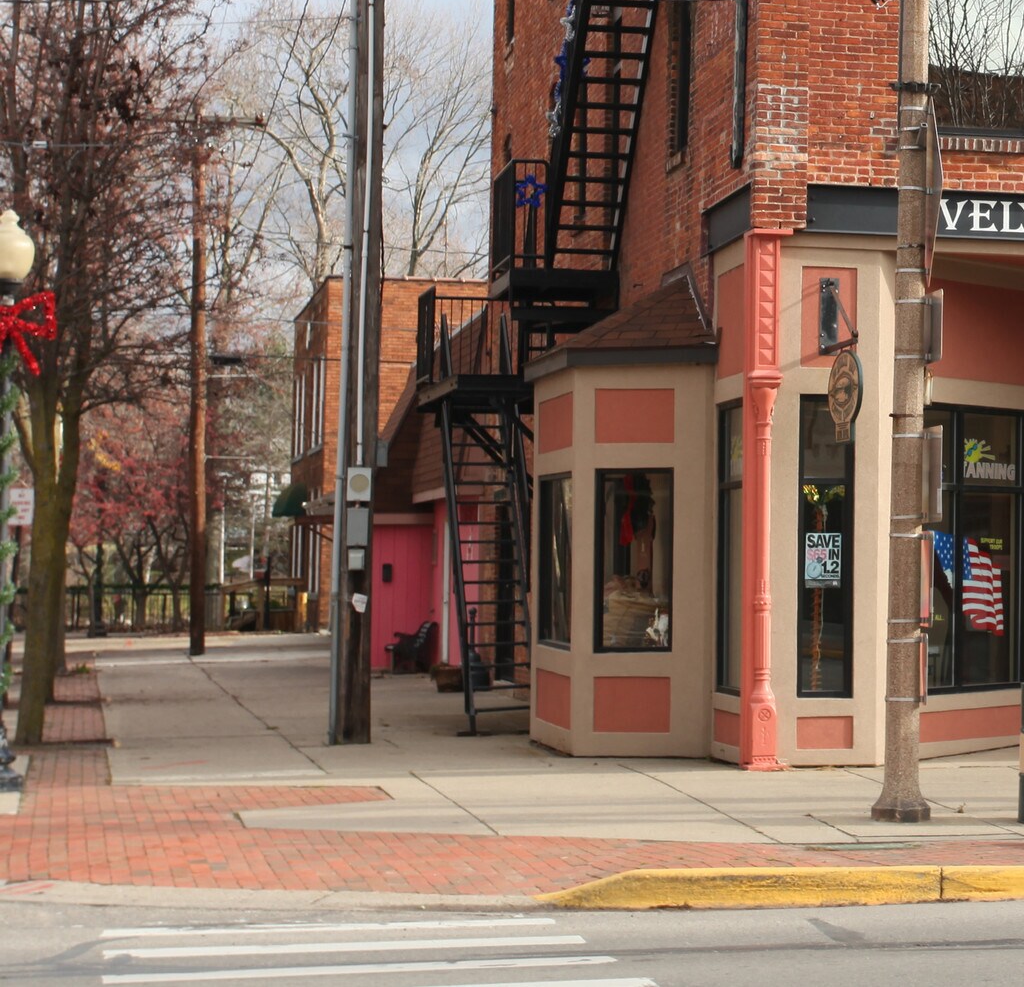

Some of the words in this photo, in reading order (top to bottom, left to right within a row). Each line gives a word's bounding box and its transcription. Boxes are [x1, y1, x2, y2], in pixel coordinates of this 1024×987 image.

[807, 534, 840, 548] SAVE
[806, 549, 827, 561] $65
[828, 549, 839, 560] IN
[821, 560, 840, 574] 1.2
